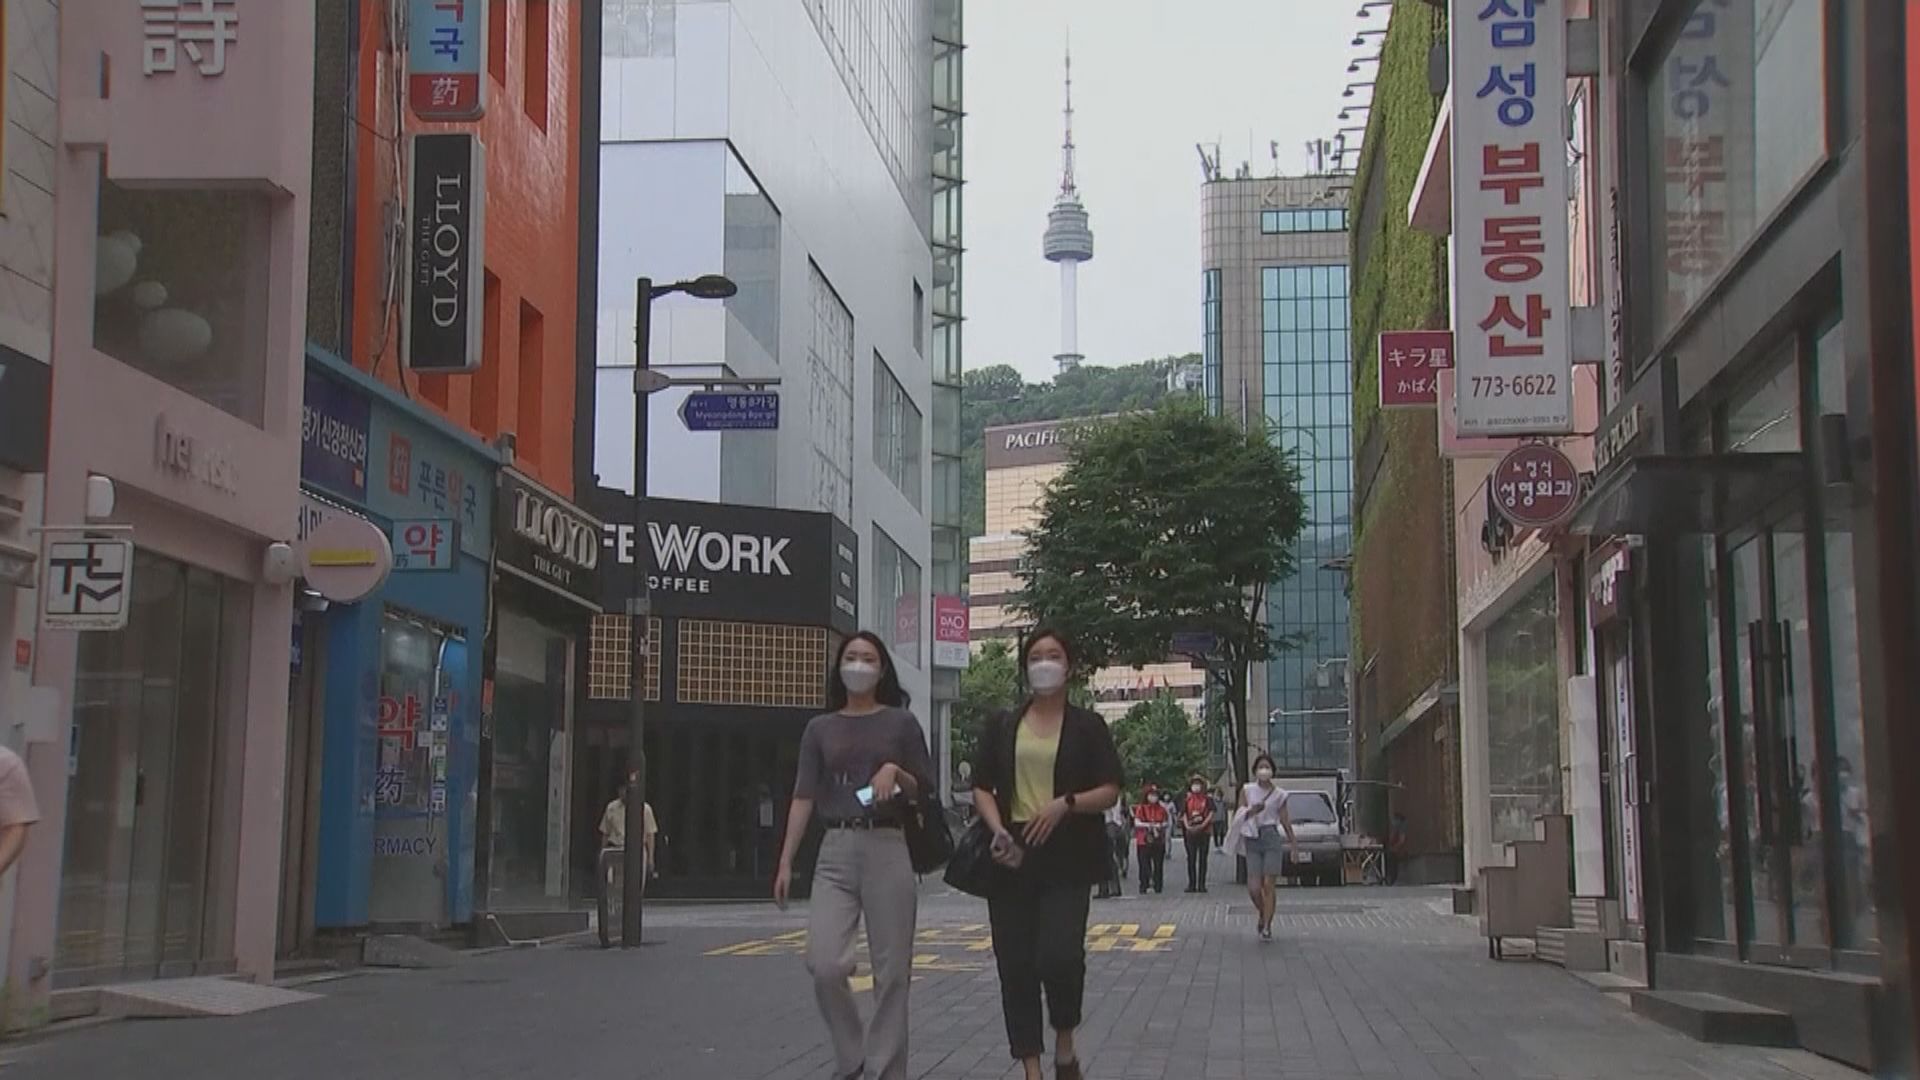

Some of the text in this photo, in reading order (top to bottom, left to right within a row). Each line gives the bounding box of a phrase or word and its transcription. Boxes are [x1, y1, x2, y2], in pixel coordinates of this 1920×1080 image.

[431, 173, 461, 328] LLOYD
[1387, 348, 1449, 368] キラ星
[1397, 377, 1438, 393] かばん
[1471, 374, 1557, 398] 773-6622
[417, 460, 477, 525] 푸른약국
[1500, 479, 1573, 508] 성형외과
[404, 522, 444, 567] 약
[512, 487, 598, 570] LLOYD
[646, 521, 792, 576] WORK
[377, 695, 422, 750] 약
